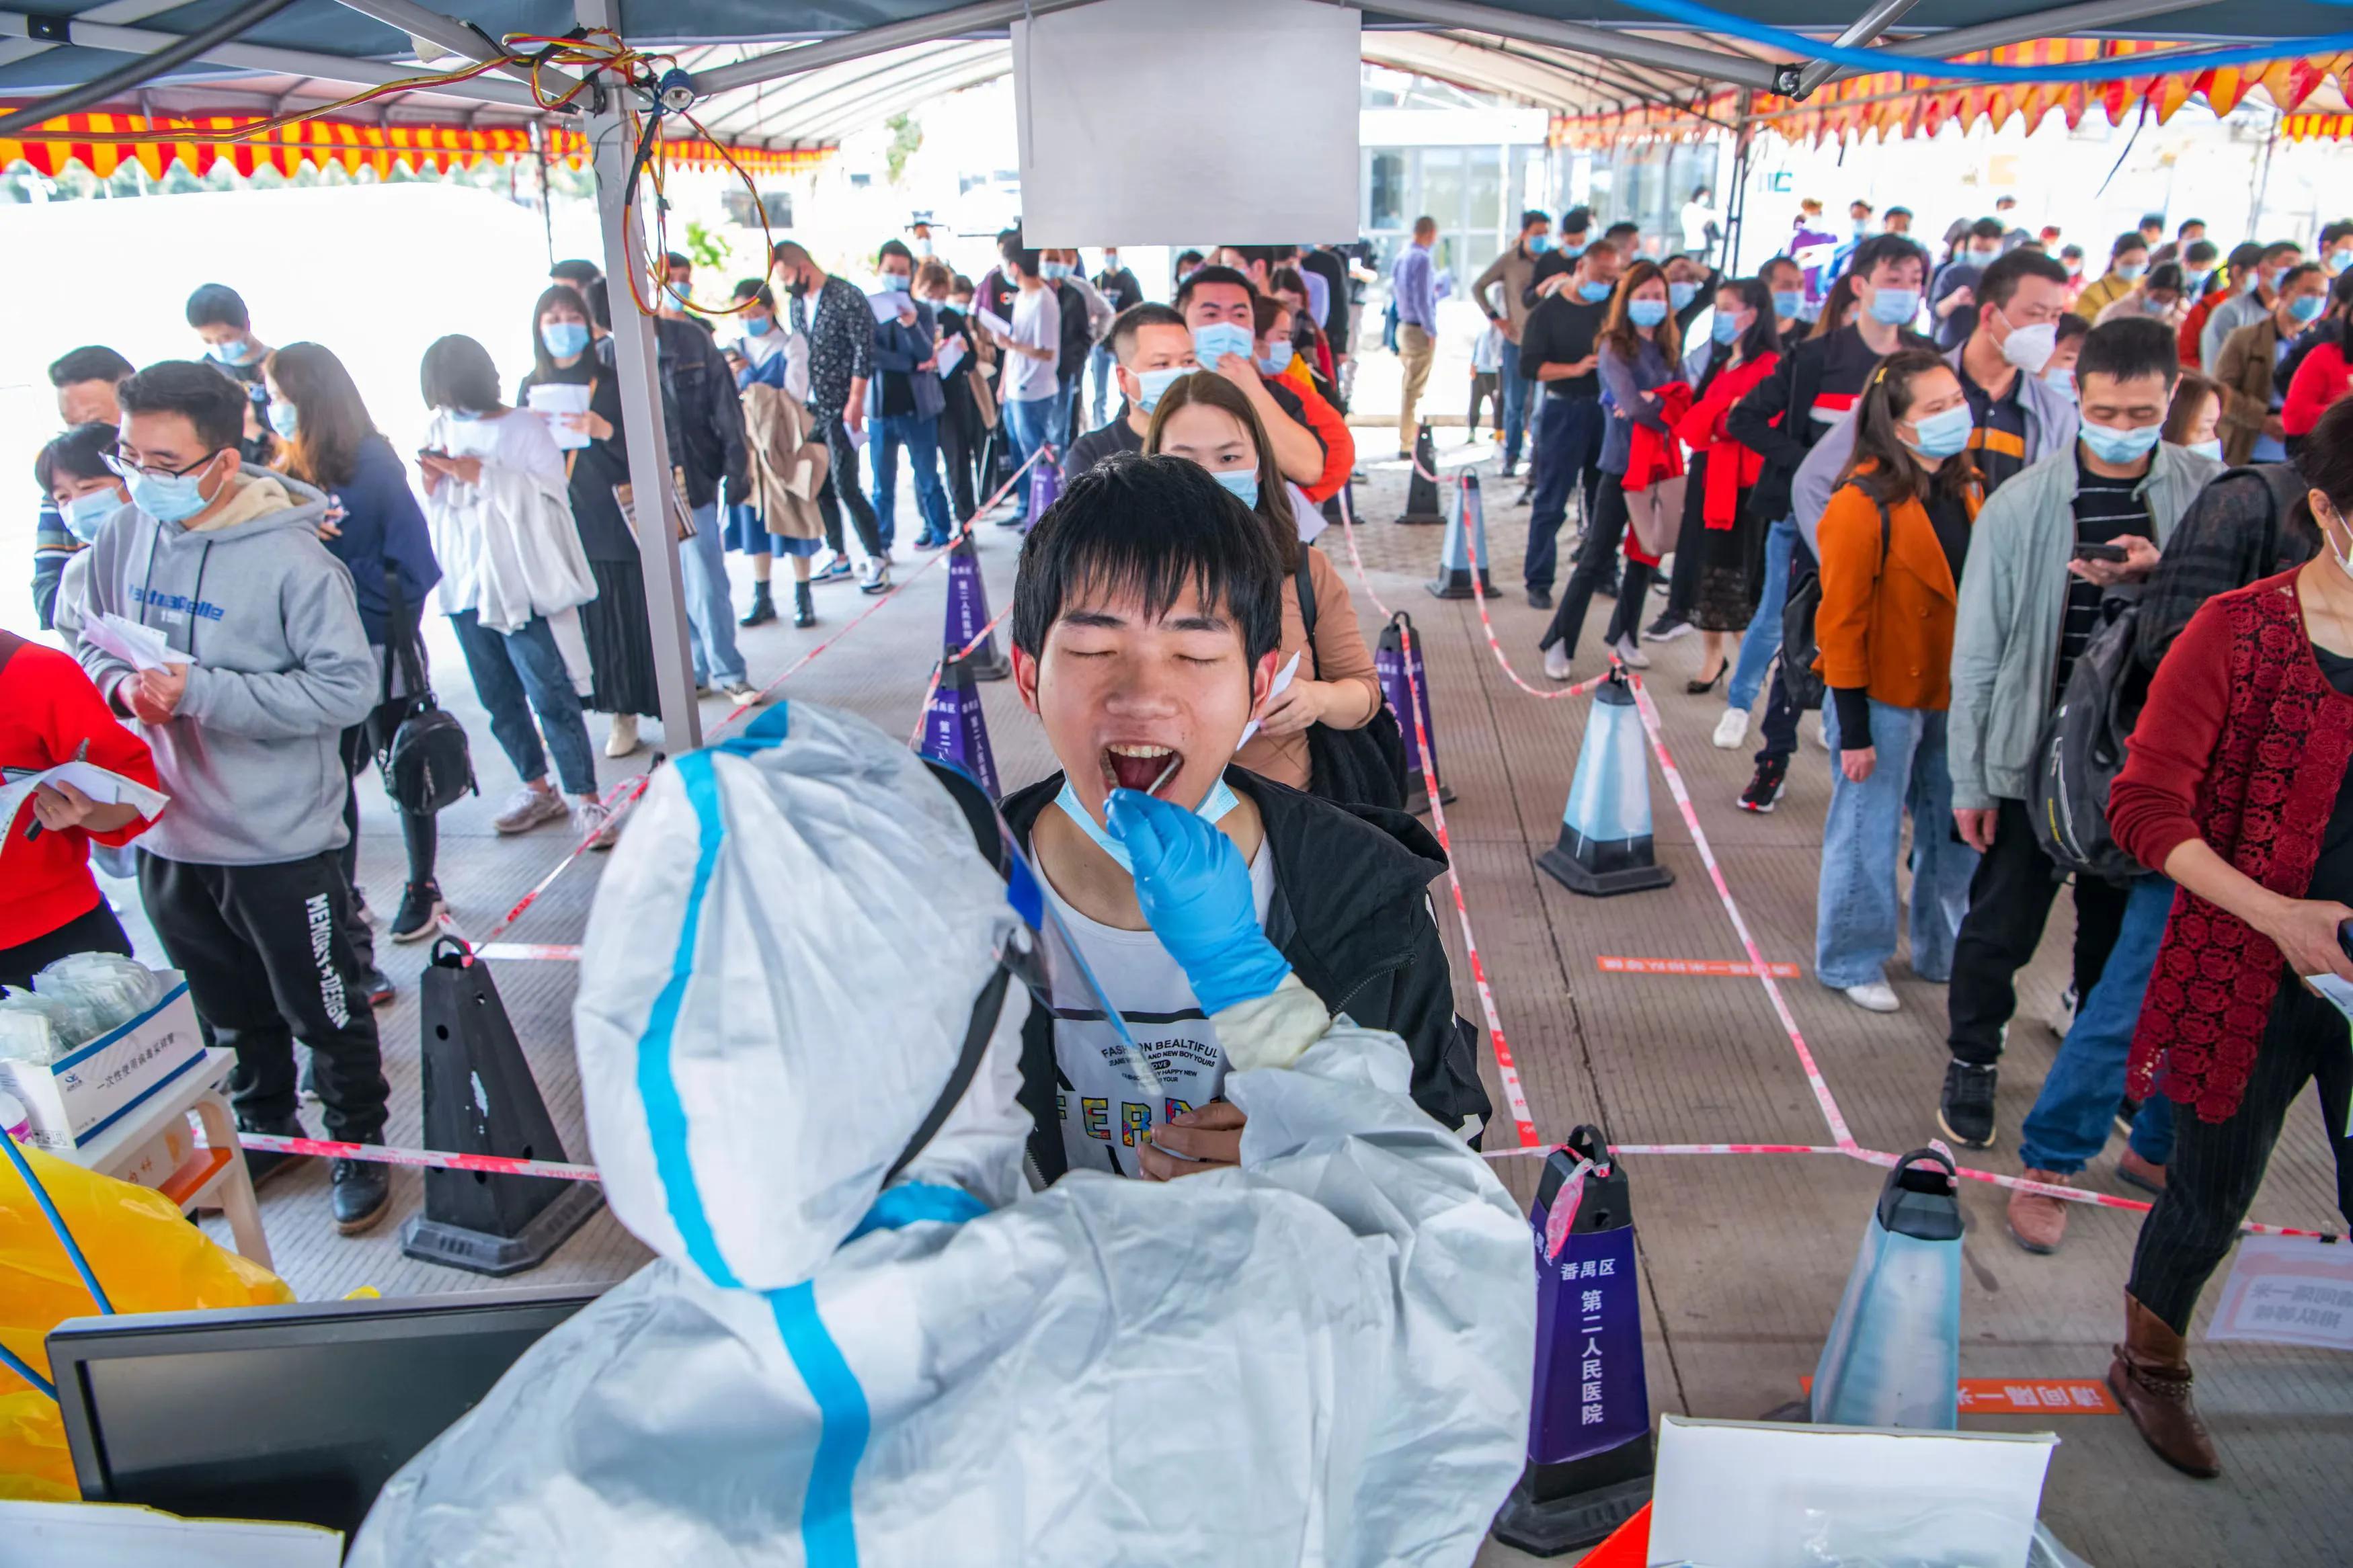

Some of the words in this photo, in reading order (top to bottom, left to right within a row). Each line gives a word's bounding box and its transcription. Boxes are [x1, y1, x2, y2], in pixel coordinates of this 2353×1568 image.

[306, 893, 332, 968] MEMORY
[319, 973, 350, 1030] DESIGN
[1101, 1042, 1152, 1059] FASN
[1156, 1039, 1218, 1058] BEALTIFUL
[1179, 1050, 1193, 1059] BOY
[1194, 1055, 1215, 1067] YOURS
[1560, 1257, 1616, 1281] 番禺区
[1581, 1289, 1603, 1426] 第二人民医院
